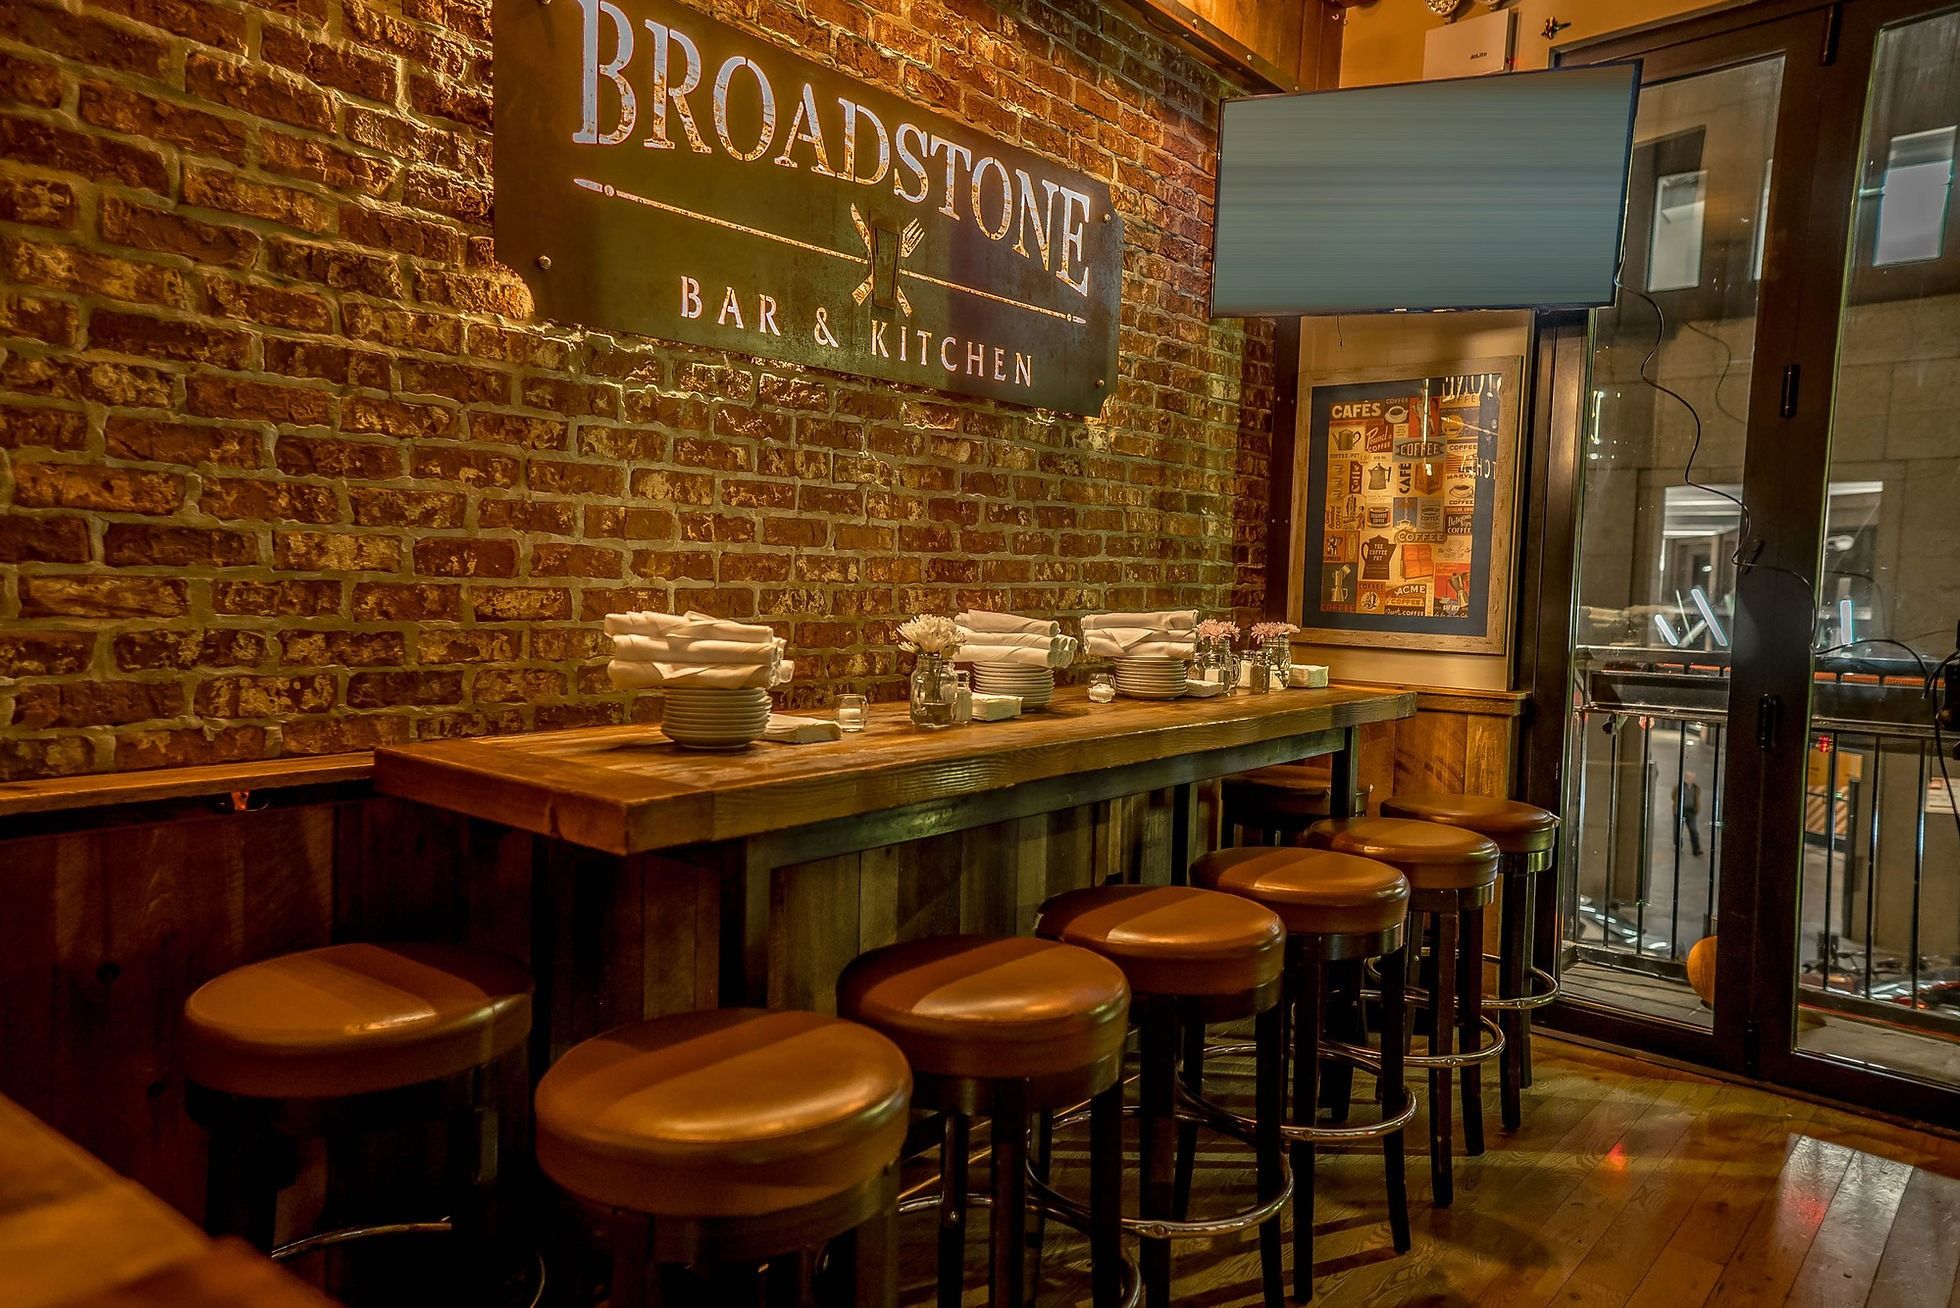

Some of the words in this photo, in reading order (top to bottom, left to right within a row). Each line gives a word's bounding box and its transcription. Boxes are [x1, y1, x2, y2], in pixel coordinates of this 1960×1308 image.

[573, 0, 1091, 298] BROADSTONE
[681, 275, 781, 337] BAR
[813, 307, 839, 349] &
[871, 318, 1034, 388] KITCHEN
[1400, 442, 1439, 456] COFFEE
[1398, 531, 1444, 541] COFFEE
[1322, 603, 1355, 612] COFFEE
